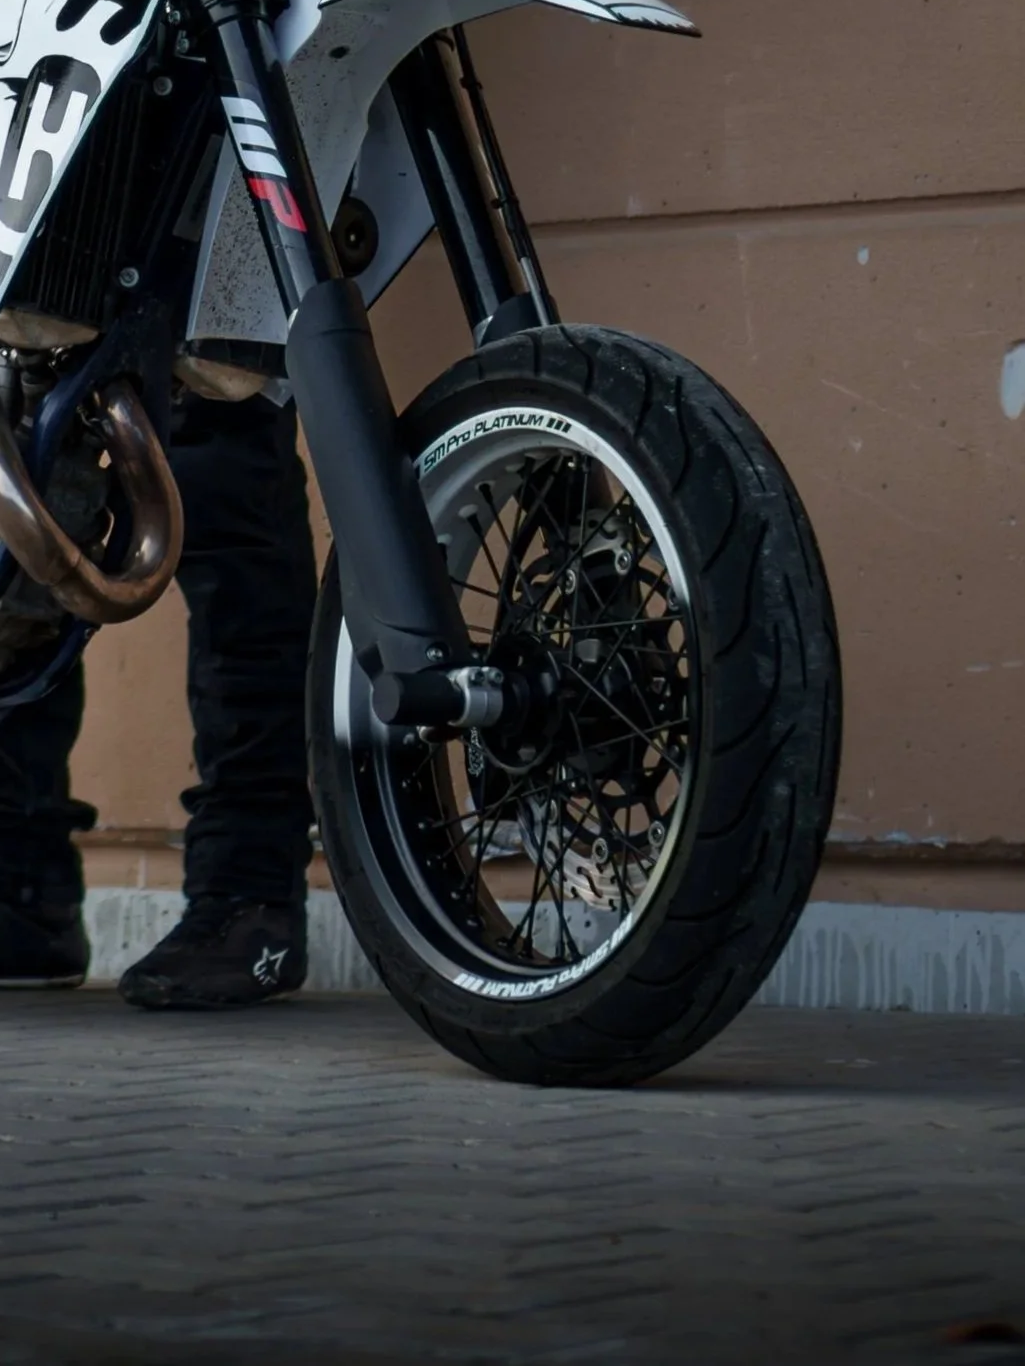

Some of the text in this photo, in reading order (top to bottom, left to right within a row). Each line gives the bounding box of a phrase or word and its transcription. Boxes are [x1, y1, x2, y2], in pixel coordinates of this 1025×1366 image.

[446, 431, 471, 452] Pro
[473, 413, 544, 437] PLATINUM
[558, 958, 587, 983] Pro
[483, 973, 558, 997] PLATINUM
